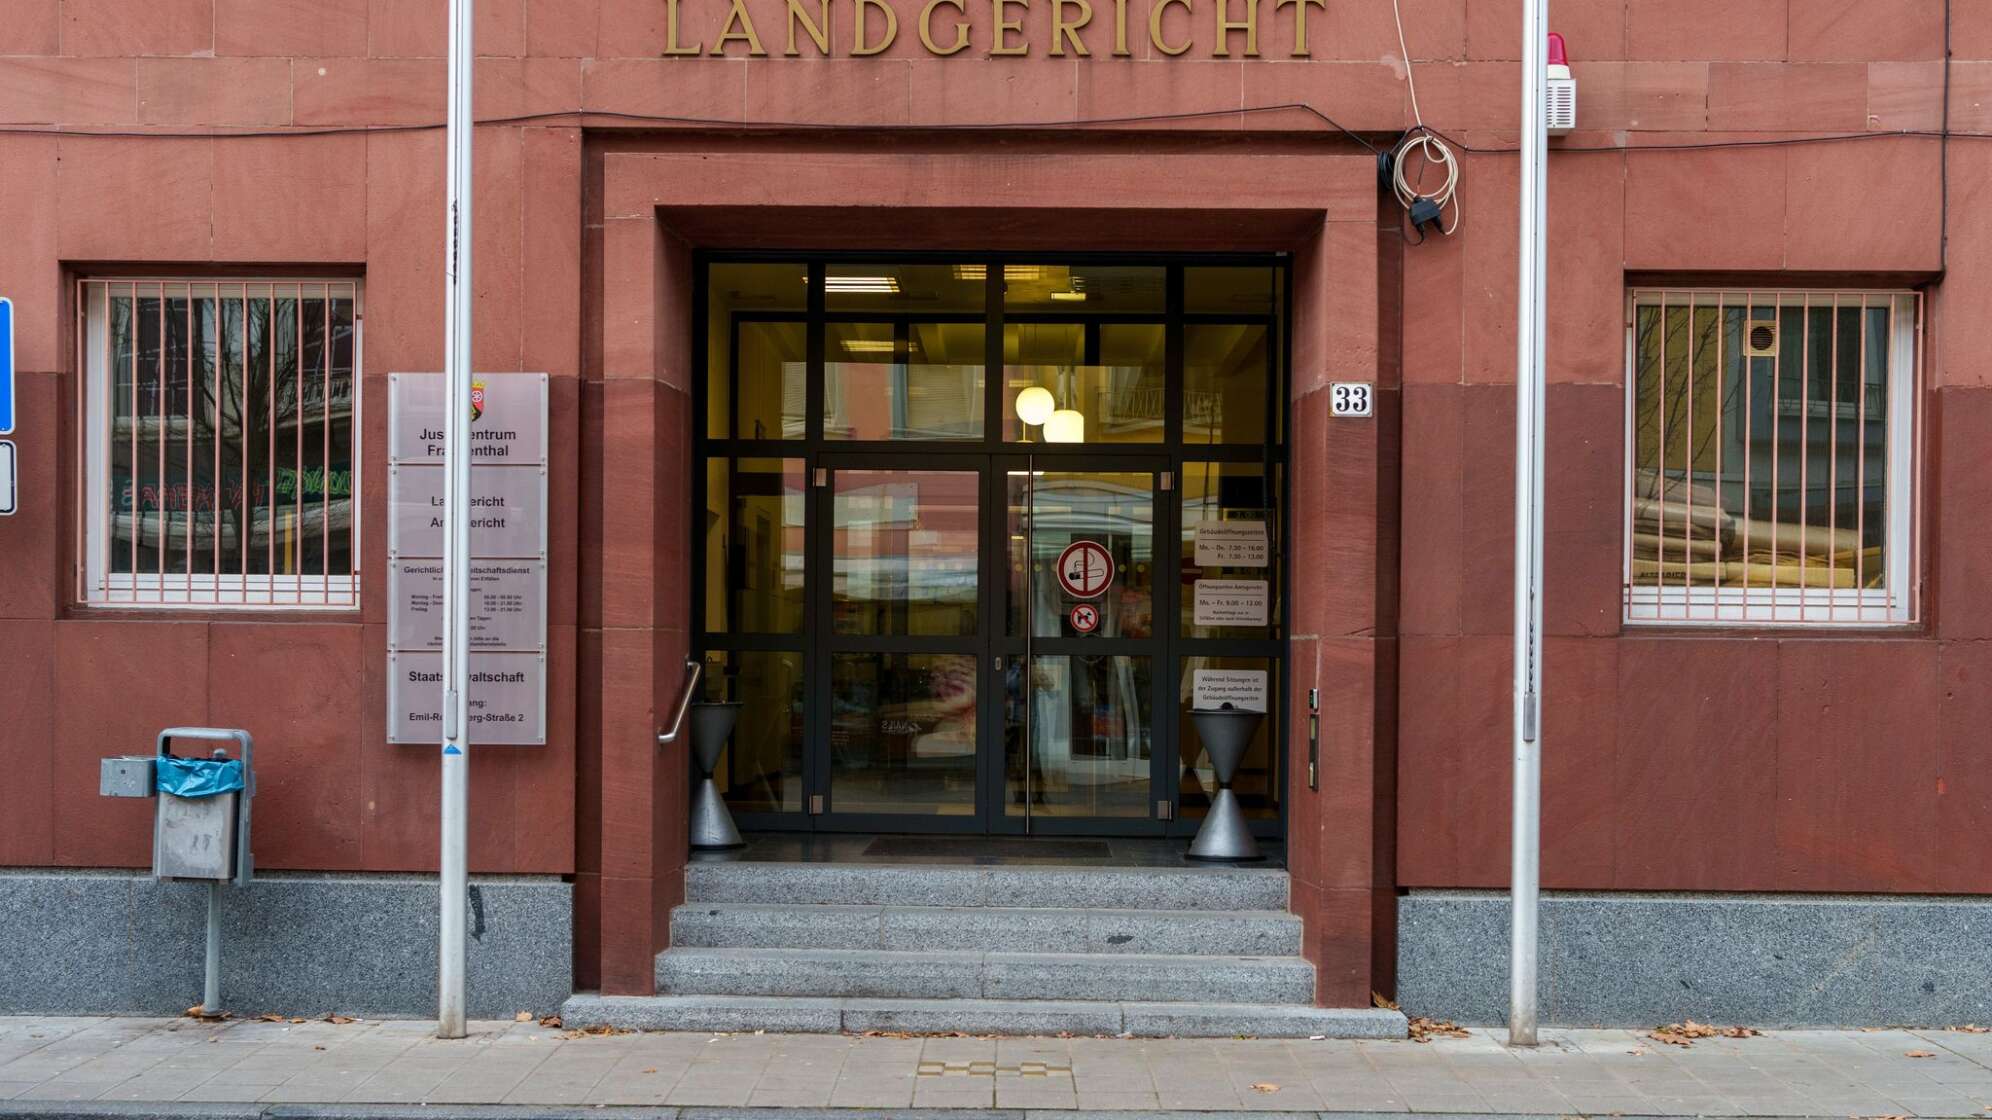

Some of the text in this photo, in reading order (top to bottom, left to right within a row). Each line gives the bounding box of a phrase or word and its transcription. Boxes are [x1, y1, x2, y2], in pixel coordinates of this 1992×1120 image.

[662, 0, 1326, 57] LANDGERICHT
[1336, 386, 1367, 412] 33
[419, 428, 517, 441] Jusentrum
[427, 444, 509, 457] Frnthal
[431, 496, 505, 507] Laericht
[430, 517, 505, 529] Aericht
[409, 671, 525, 683] Staataltschaft
[409, 713, 524, 723] Emil-Rerg-Straße 2
